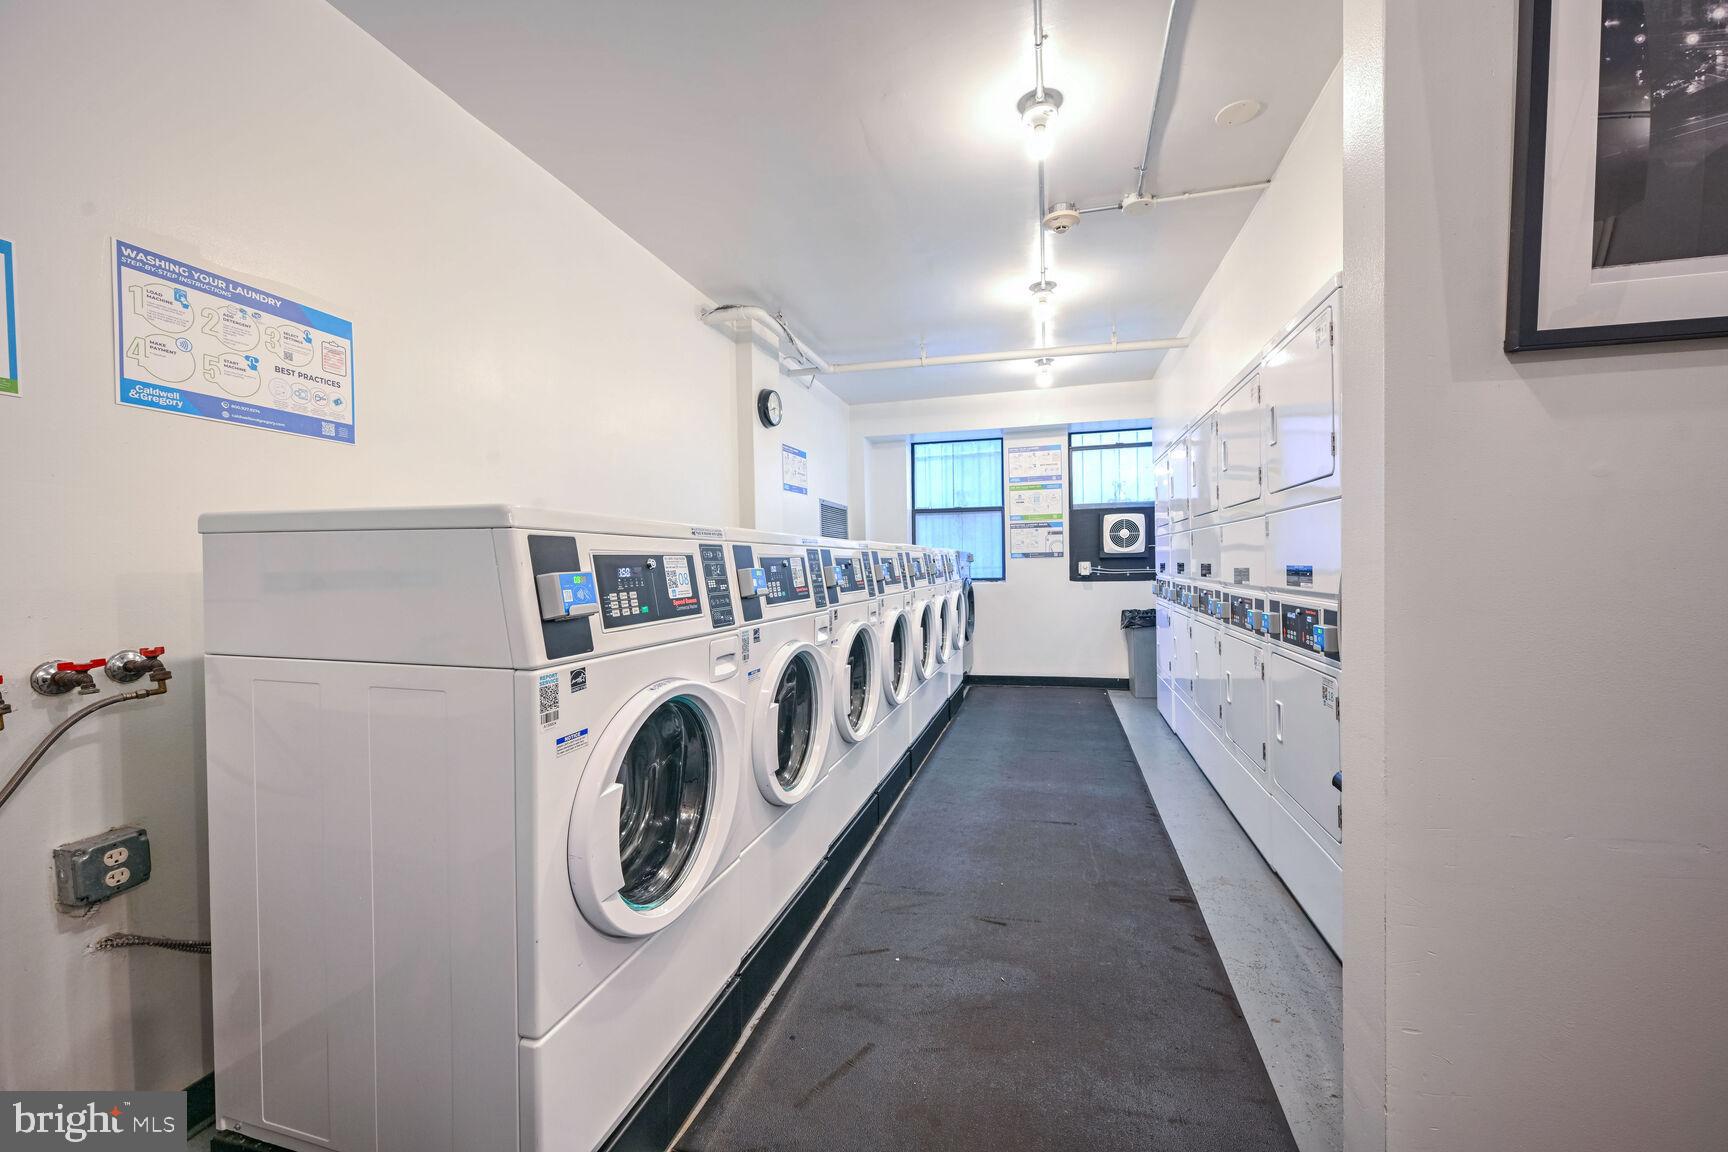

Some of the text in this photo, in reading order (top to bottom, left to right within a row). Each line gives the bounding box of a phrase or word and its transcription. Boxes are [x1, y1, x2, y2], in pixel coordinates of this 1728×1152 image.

[121, 246, 282, 308] WASHING YOUR LAUNDRY
[121, 256, 232, 298] STEP-BY-STEP INSTRUCTIONS
[146, 289, 163, 298] LOAD
[146, 294, 174, 305] MACHINE
[149, 340, 167, 348] MAKE
[149, 345, 177, 355] PAYMENT
[223, 364, 247, 372] MACHINE
[275, 366, 295, 376] BEST
[298, 371, 341, 389] PRACTICES
[136, 385, 180, 399] Caldwell
[564, 732, 581, 742] NOTICE
